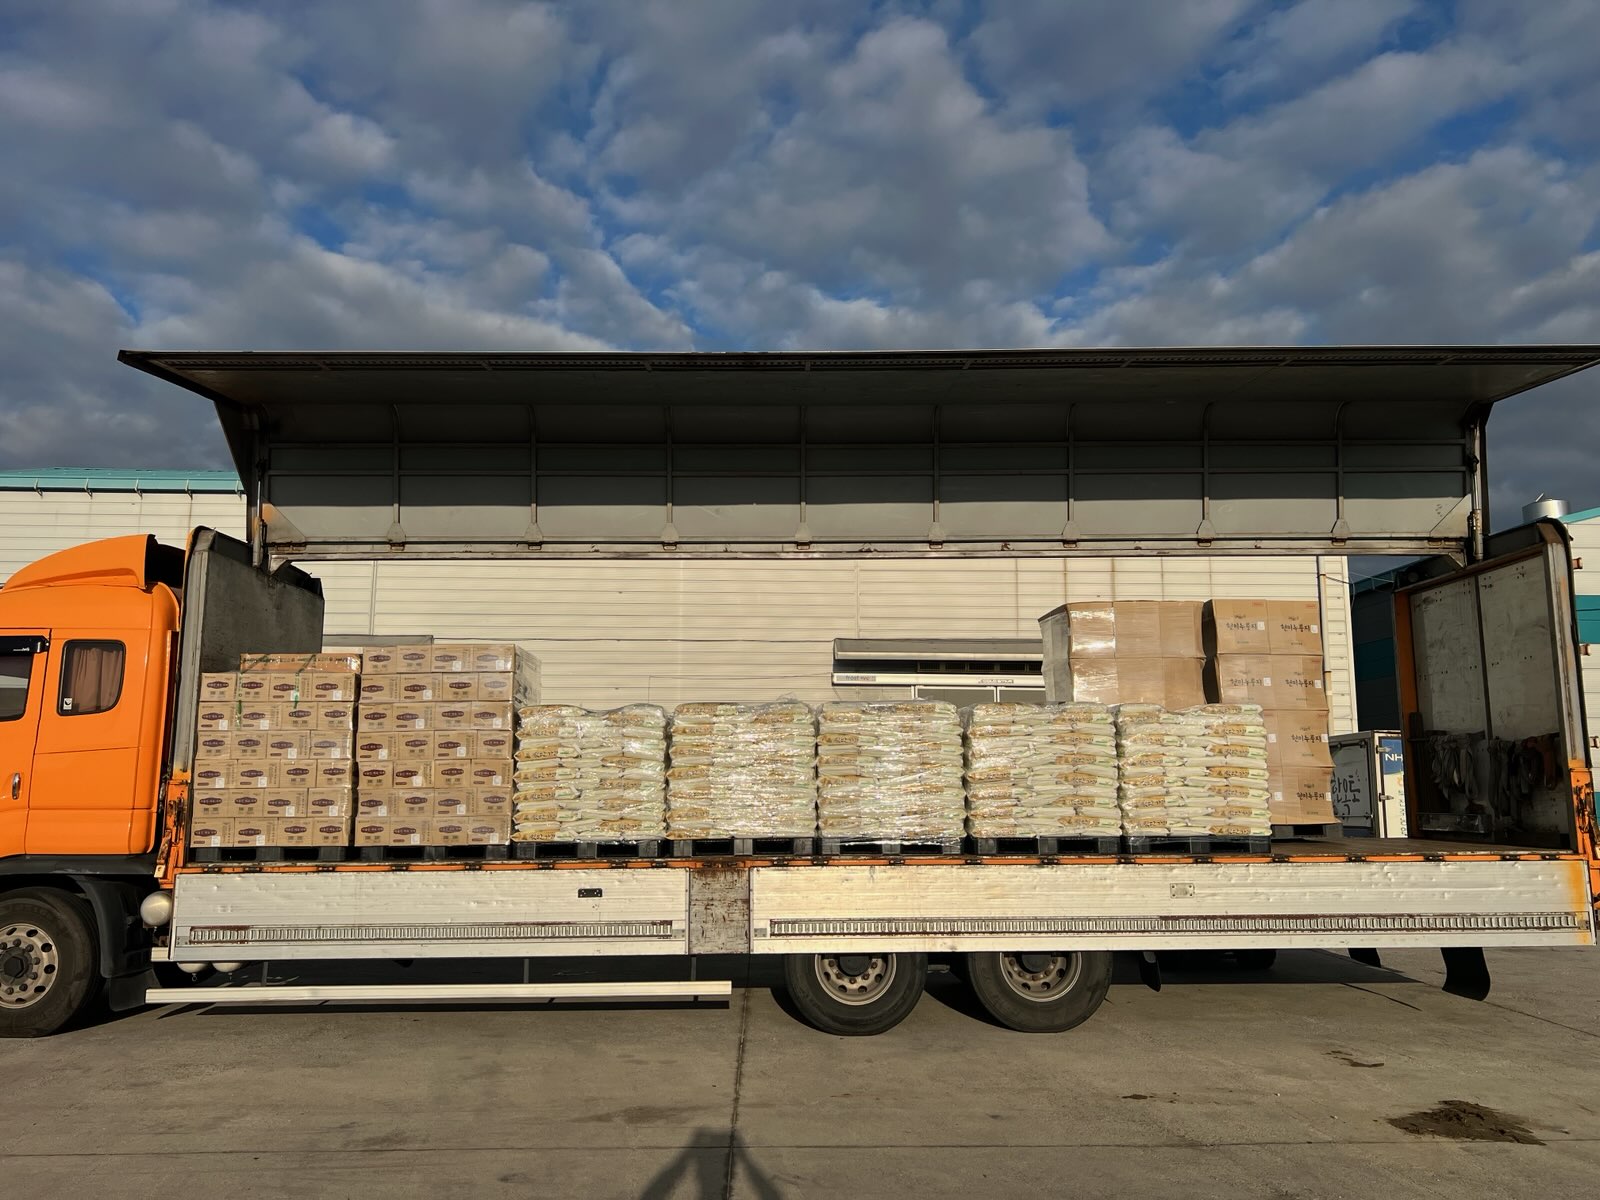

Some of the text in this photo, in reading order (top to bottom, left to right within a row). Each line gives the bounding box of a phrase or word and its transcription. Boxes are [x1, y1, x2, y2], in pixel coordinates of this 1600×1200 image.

[1280, 623, 1311, 633] 현미누룽지
[1285, 678, 1314, 688] 현미누룽지
[1291, 733, 1322, 743] 현미누룽지
[1384, 753, 1403, 762] NH
[1296, 791, 1325, 801] 현미누룽지
